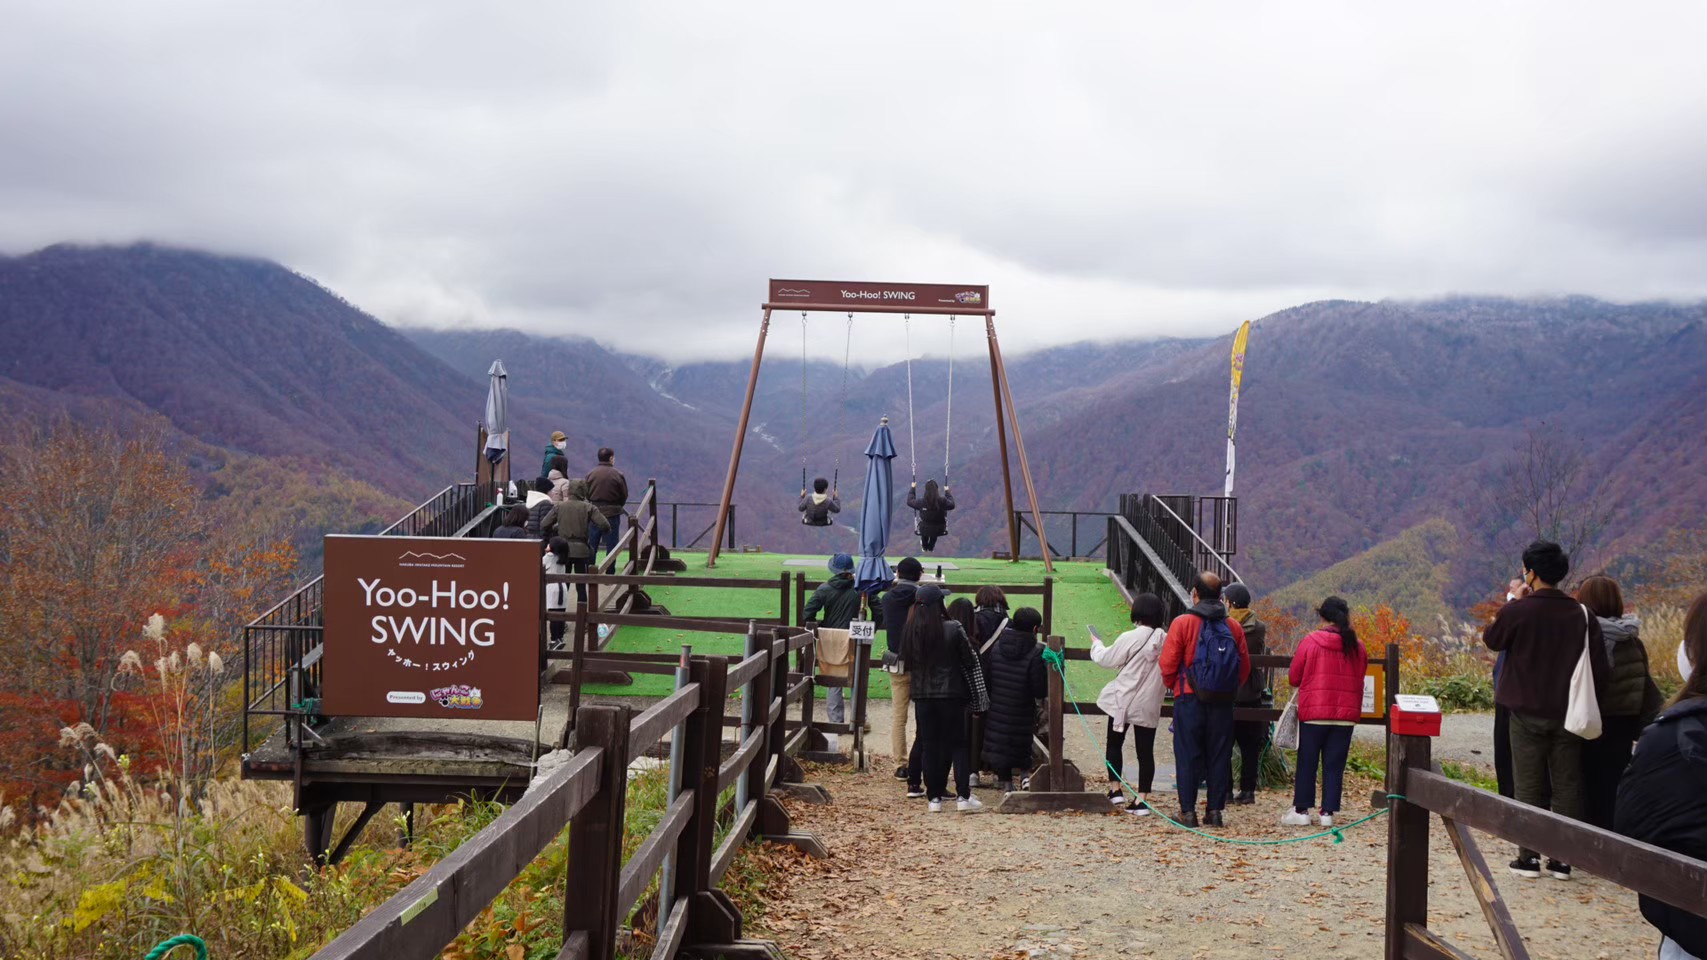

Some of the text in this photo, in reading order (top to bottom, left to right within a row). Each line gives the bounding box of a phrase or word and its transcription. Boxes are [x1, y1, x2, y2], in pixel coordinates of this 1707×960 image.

[841, 290, 916, 300] Yoo-Hoo! SWING
[357, 577, 509, 610] Yoo-Hoo!
[371, 615, 495, 647] SWING
[852, 625, 873, 637] 受付
